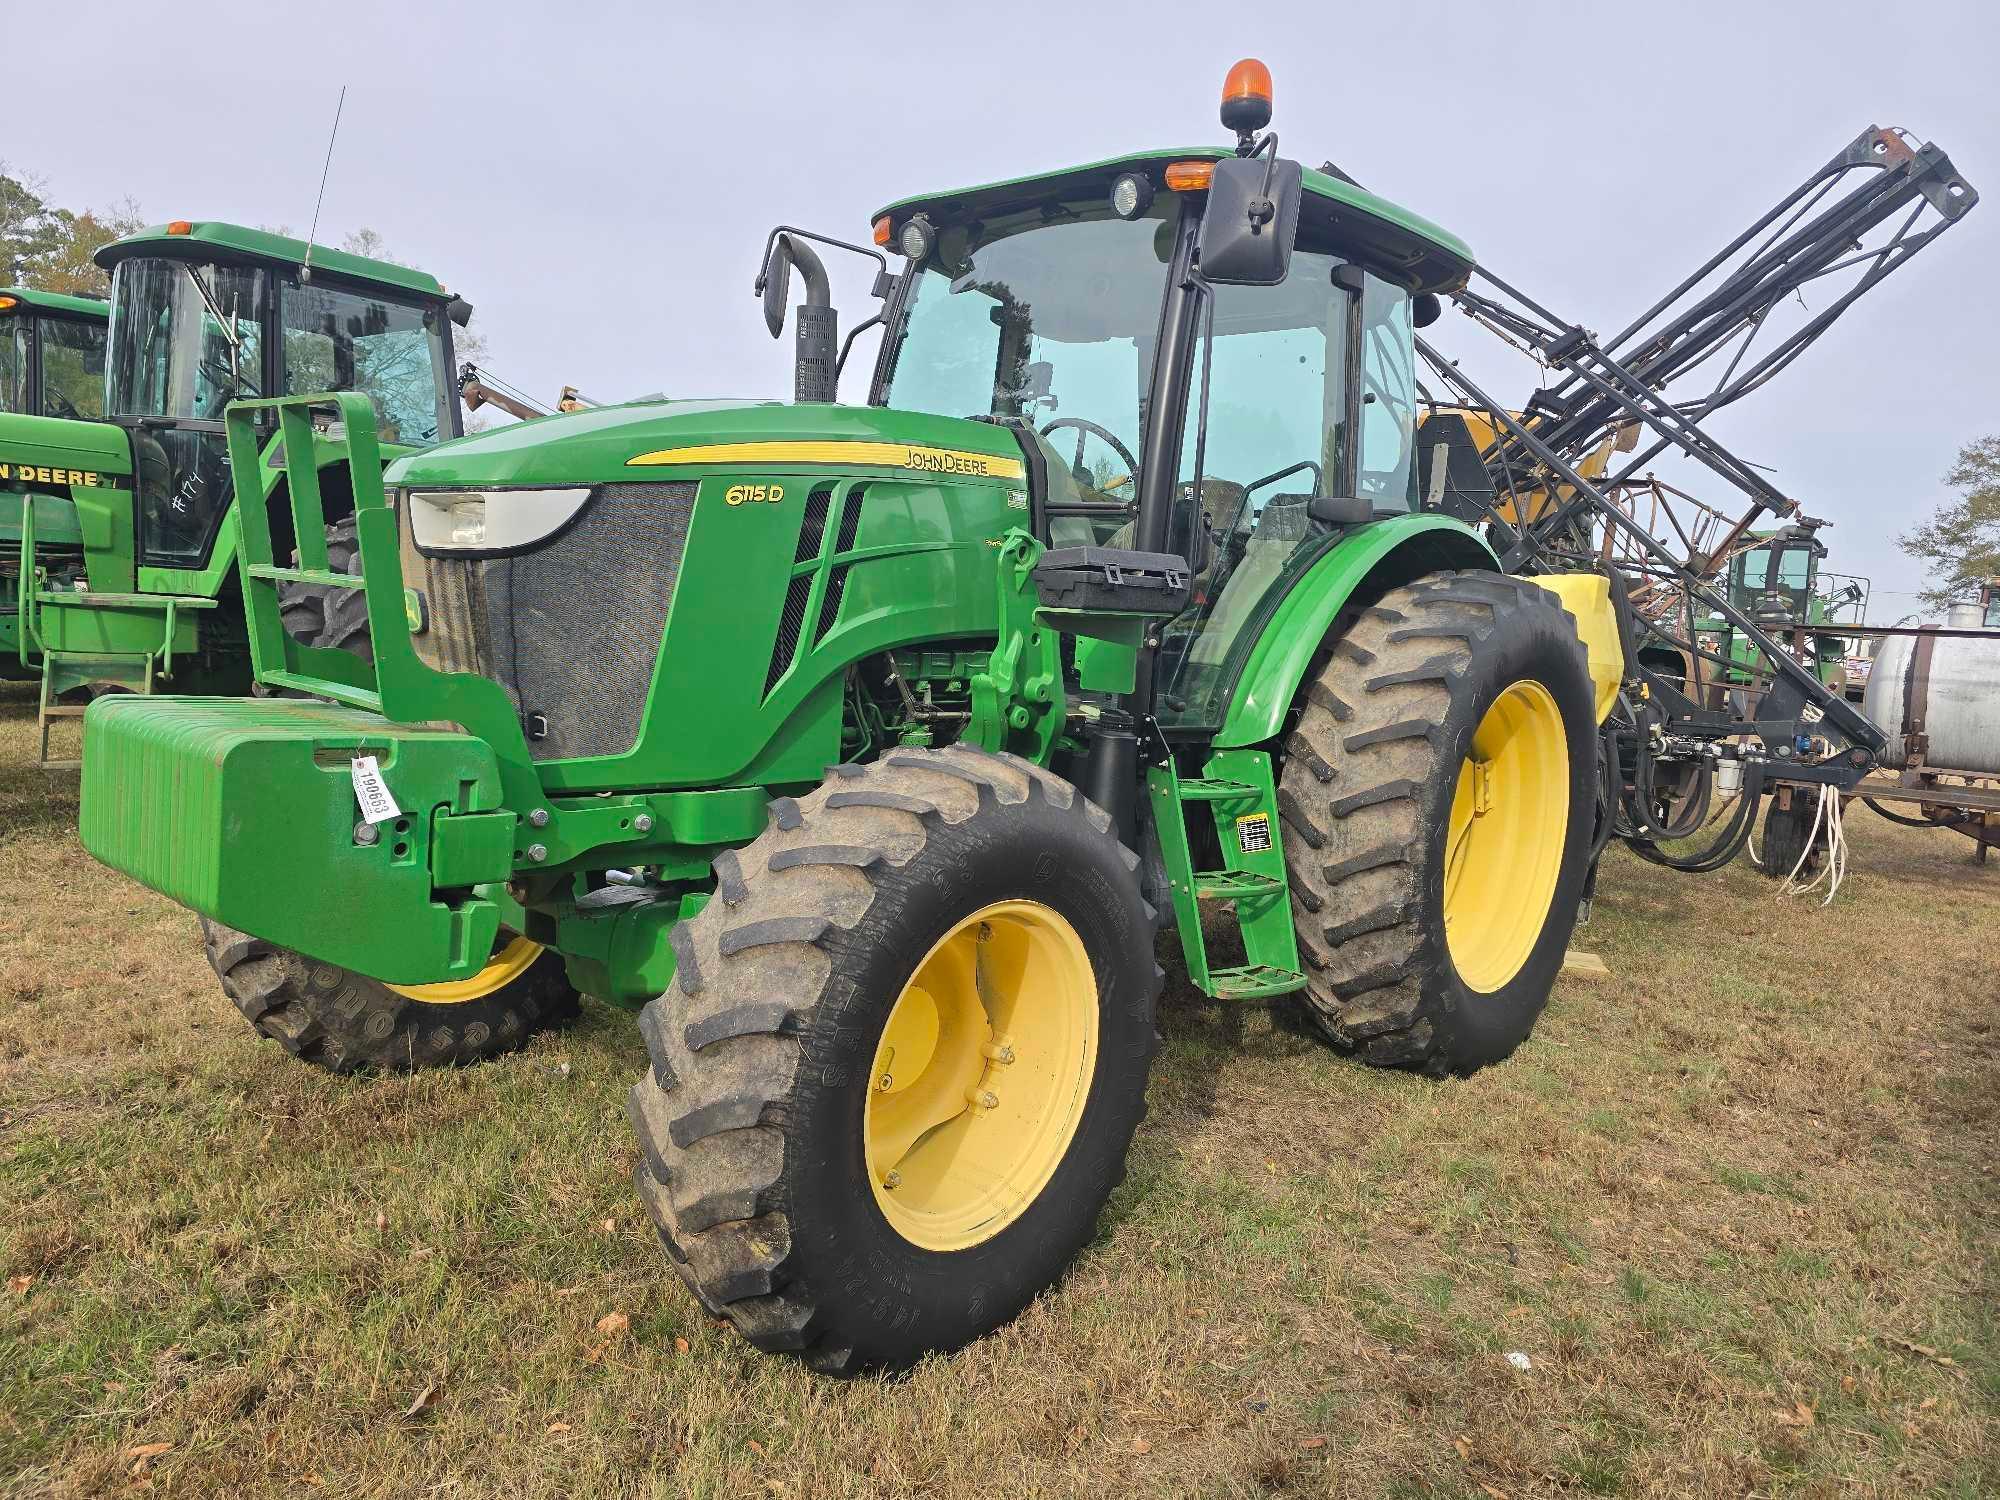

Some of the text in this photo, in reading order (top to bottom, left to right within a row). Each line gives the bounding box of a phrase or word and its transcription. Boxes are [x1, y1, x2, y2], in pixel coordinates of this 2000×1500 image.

[19, 465, 98, 487] DEERE
[904, 448, 989, 476] JOHN DEERE
[171, 470, 205, 513] #174
[359, 770, 390, 815] 190663
[311, 965, 562, 1050] irestone
